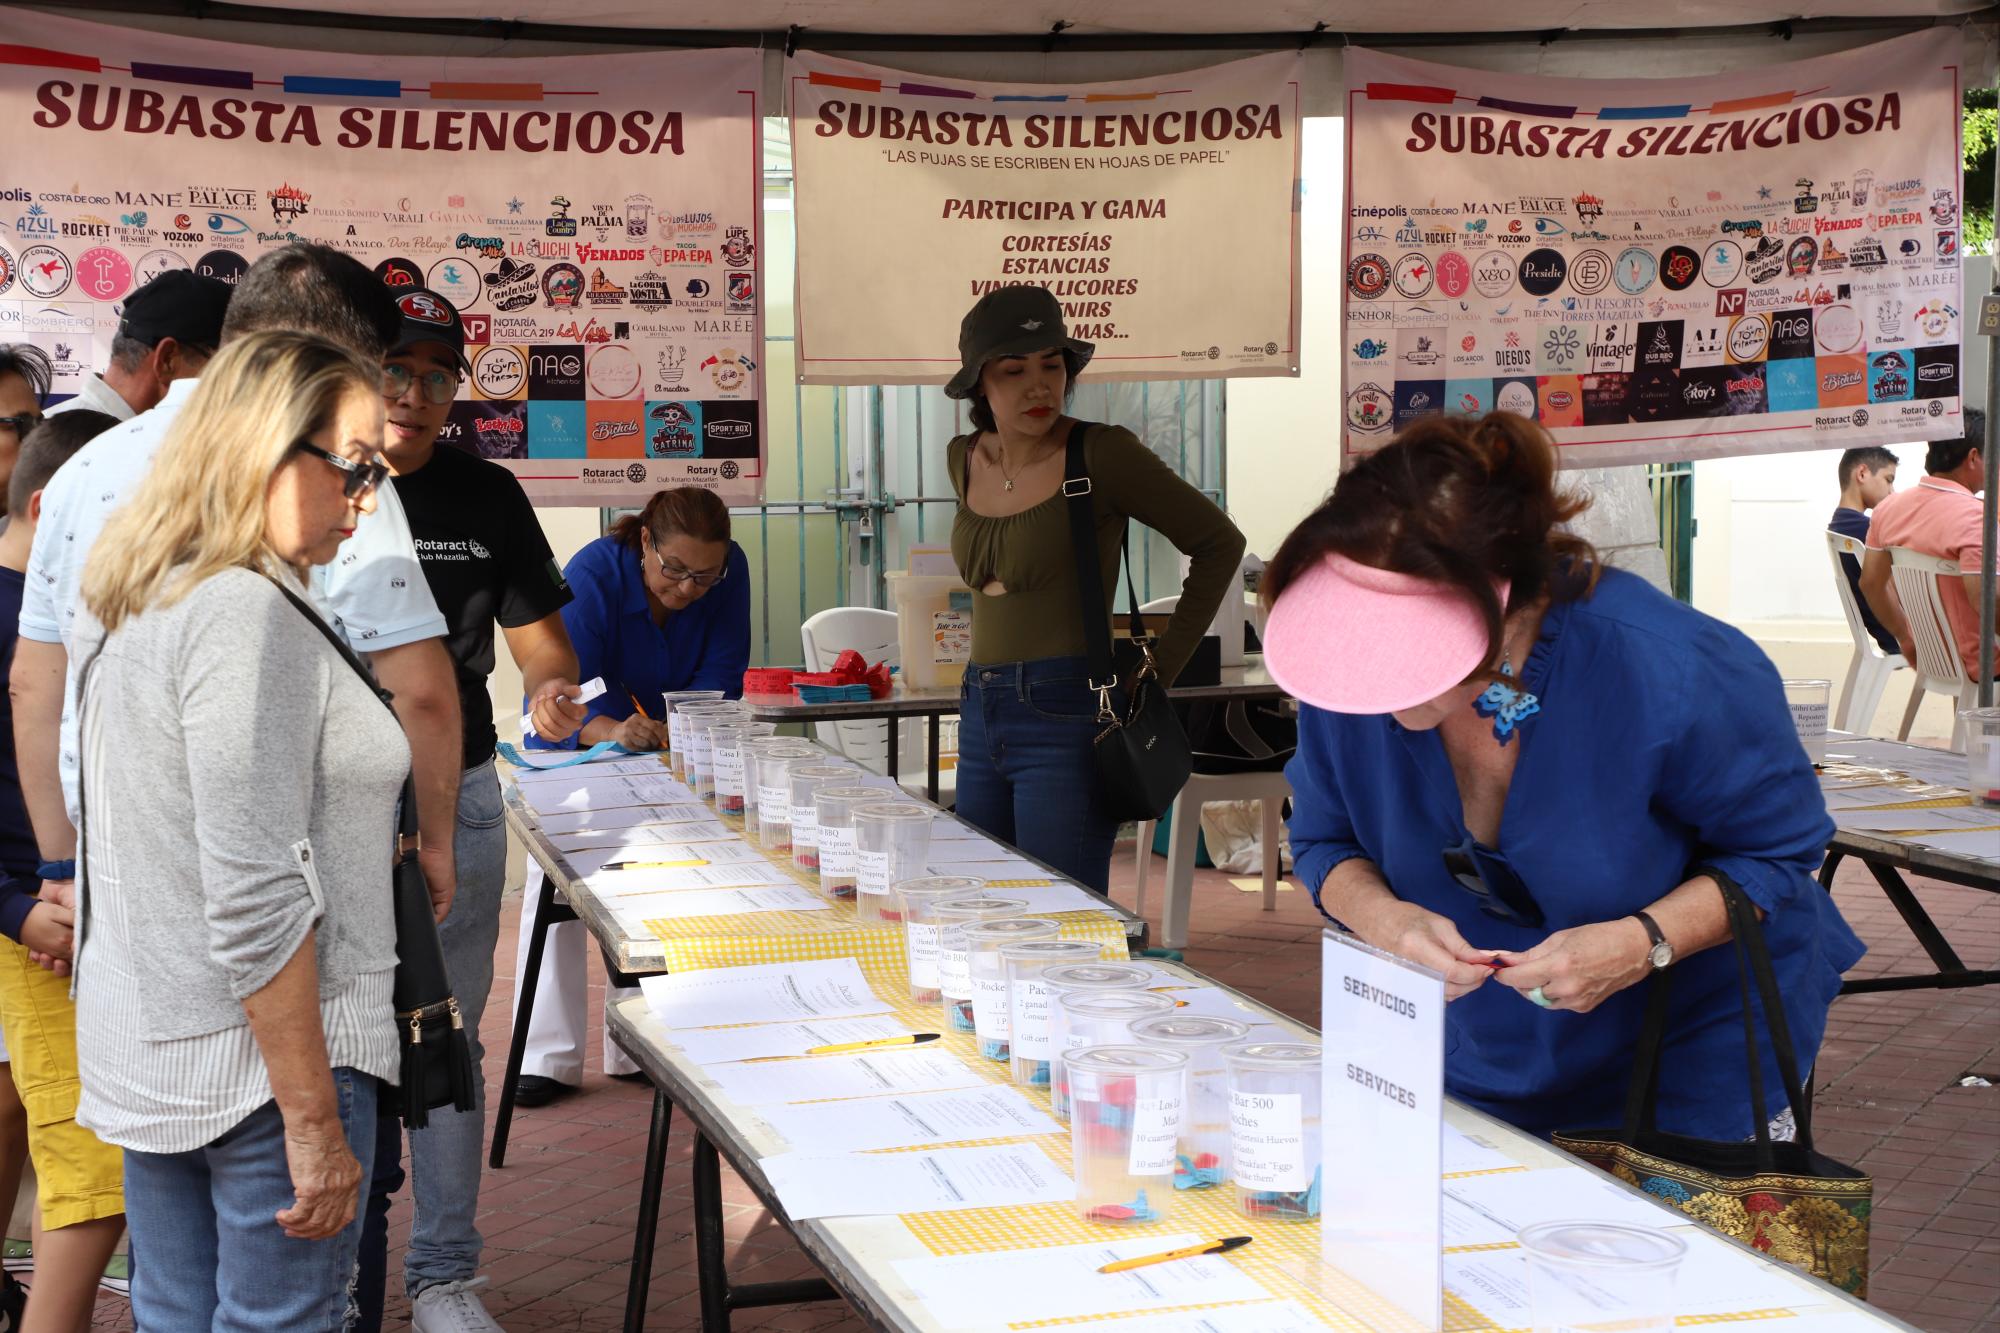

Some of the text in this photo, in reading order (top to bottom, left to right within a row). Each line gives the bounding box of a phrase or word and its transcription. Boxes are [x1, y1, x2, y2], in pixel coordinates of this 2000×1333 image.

[33, 80, 685, 156] SUBASTA SILENCIOSA
[815, 100, 1283, 149] SUBASTA SILENCIOSA
[1405, 92, 1901, 159] SUBASTA SILENCIOSA
[920, 150, 967, 168] PUJAS
[970, 154, 990, 169] SE
[994, 155, 1070, 170] ESCRIBEN
[1074, 155, 1097, 170] EN
[1100, 153, 1150, 170] HOJAS
[1154, 151, 1176, 166] DE
[39, 193, 110, 205] COSTA DE ORO
[190, 191, 257, 207] PALACE
[1821, 190, 1851, 201] PALMA
[1933, 191, 1953, 200] LUPE
[277, 197, 302, 210] BBQ
[942, 198, 1167, 221] PARTICIPA Y GANA
[1520, 199, 1567, 212] PALACE
[1579, 203, 1599, 212] BBQ
[684, 213, 712, 224] LUJOS
[1351, 204, 1408, 219] cinépolis
[17, 217, 58, 233] AZUL
[581, 217, 623, 227] PALMA
[1814, 215, 1864, 236] VENADOS
[1878, 212, 1923, 228] EPA-EPA
[62, 223, 110, 237] ROCKET
[725, 229, 748, 239] LUPE
[1767, 222, 1778, 234] LA
[163, 232, 204, 242] YOZOKO
[1001, 231, 1113, 252] CORTESÍAS
[1396, 229, 1424, 243] AZUL
[1425, 233, 1457, 244] ROCKET
[1497, 235, 1531, 243] YOZOKO
[511, 241, 524, 256] LA
[575, 242, 645, 264] VENADOS
[664, 250, 713, 265] EPA-EPA
[1001, 257, 1111, 274] ESTANCIAS
[1056, 278, 1139, 296] LICORES
[1908, 272, 1957, 288] MARÉE
[1719, 293, 1744, 314] NP
[1347, 311, 1392, 321] SENHOR
[694, 317, 753, 333] MARÉE
[1071, 322, 1130, 340] MAS...
[539, 328, 555, 338] 219
[1243, 345, 1264, 353] Rotary
[1586, 343, 1634, 361] Vintage
[1496, 350, 1531, 366] DIEGO'S
[530, 355, 580, 376] NAO
[1690, 385, 1716, 400] Roy's
[1901, 406, 1927, 415] Rotary
[1815, 414, 1851, 426] Rotaract
[710, 425, 749, 433] SPORT BOX
[654, 439, 694, 450] CATRINA
[583, 468, 624, 478] Rotaract
[687, 466, 718, 477] Rotary
[415, 538, 468, 551] Rotaract
[435, 552, 470, 561] Mazatlán
[823, 829, 839, 838] BBQ
[1343, 975, 1417, 1019] SERVICIOS
[1346, 1063, 1416, 1109] SERVICES
[1252, 1098, 1274, 1109] 500
[1267, 1135, 1299, 1144] Huevos
